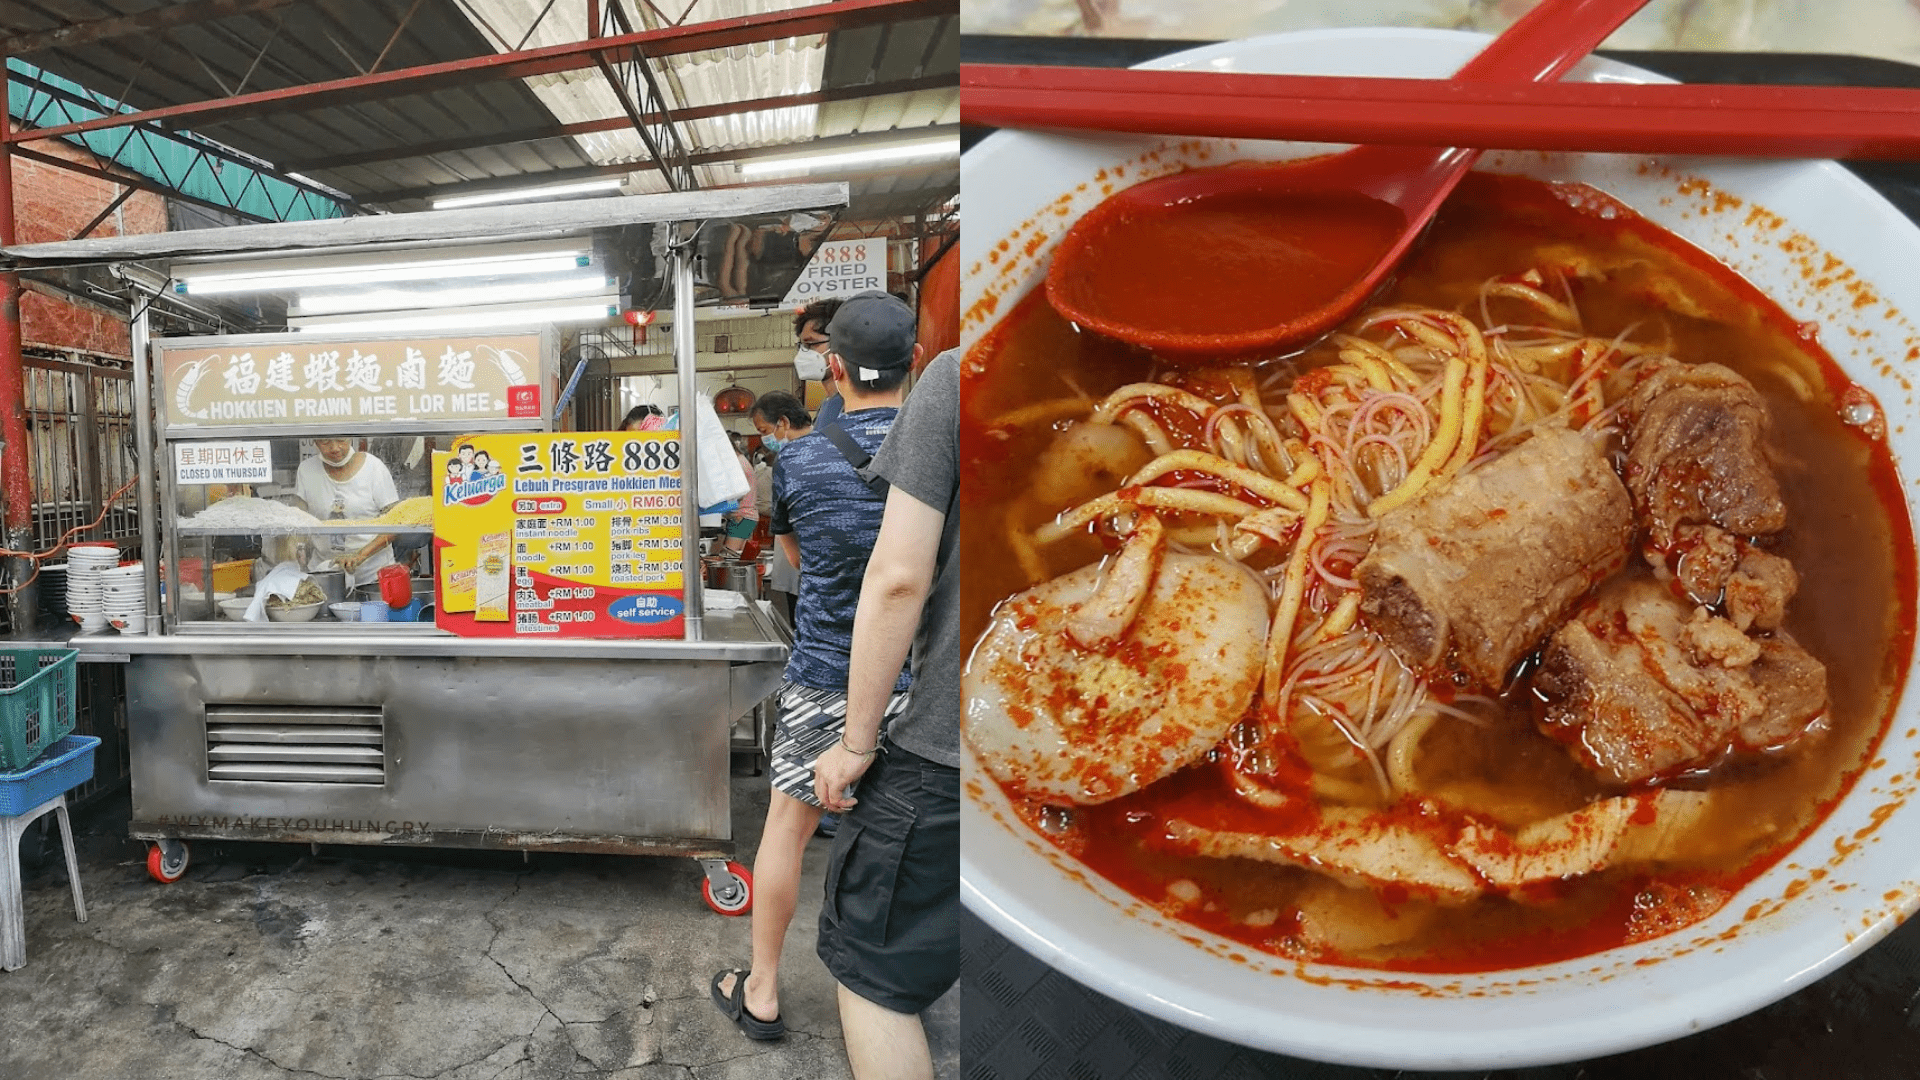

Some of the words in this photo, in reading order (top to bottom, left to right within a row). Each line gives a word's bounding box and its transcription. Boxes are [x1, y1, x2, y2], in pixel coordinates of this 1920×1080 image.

[808, 264, 867, 278] FRIED
[797, 277, 879, 293] OYSTER
[211, 399, 287, 419] HOKKIEN
[295, 397, 352, 417] PRAWN
[360, 395, 397, 415] MEE
[409, 394, 445, 413] LOR
[452, 392, 490, 412] MEE
[180, 447, 267, 465] 星期四休息
[518, 441, 615, 473] 三條路
[624, 441, 680, 470] 888
[180, 468, 210, 479] CLOSED
[213, 467, 224, 478] ON
[226, 467, 267, 478] THURSDAY
[446, 475, 505, 504] Keluarga
[515, 480, 548, 492] Lebuh
[553, 478, 607, 493] Presgrave
[611, 477, 655, 489] Hokkien
[518, 501, 535, 511] 另加
[585, 500, 613, 509] Small
[616, 499, 627, 510] 小
[516, 518, 547, 529] 家庭面
[575, 517, 595, 526] 1.00
[612, 516, 632, 527] 排骨
[663, 516, 681, 525] 3.0
[516, 529, 545, 537] instant
[549, 529, 577, 537] noodle
[611, 528, 630, 536] pork
[633, 527, 649, 535] ribs
[516, 543, 526, 553] 面
[549, 542, 570, 551] +RM
[574, 541, 594, 550] 1.00
[638, 539, 659, 548] +RM
[663, 539, 681, 548] 3.0
[633, 552, 646, 561] leg
[549, 565, 571, 574] +RM
[574, 565, 594, 574] 1.00
[611, 563, 632, 574] 烧肉
[638, 563, 659, 571] +RM
[516, 578, 533, 586] egg
[611, 574, 644, 582] roasted
[645, 574, 665, 583] pork
[516, 590, 536, 600] 肉丸
[549, 588, 571, 598] +RM
[574, 588, 594, 597] 1.00
[635, 597, 658, 608] 自助
[549, 612, 571, 621] +RM
[574, 611, 594, 621] 1.00
[617, 608, 636, 618] self
[638, 608, 675, 616] service
[516, 624, 559, 632] intestines
